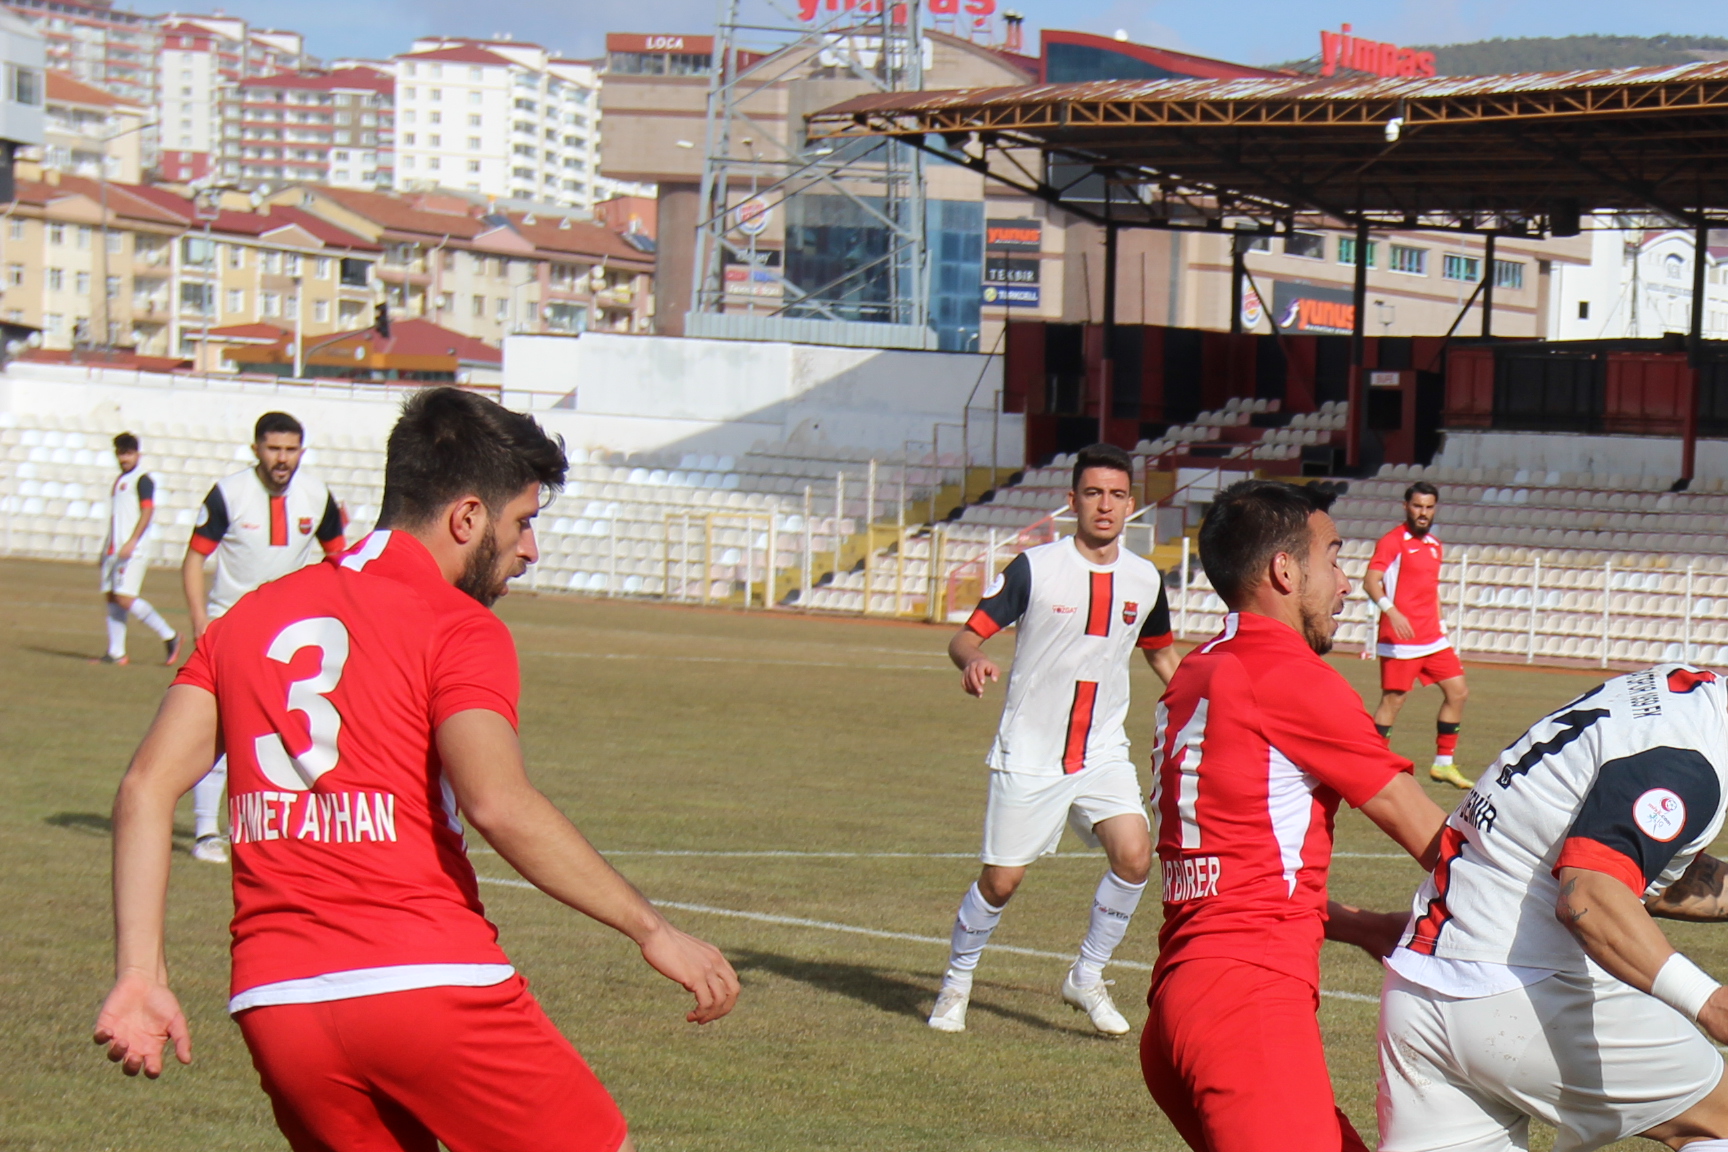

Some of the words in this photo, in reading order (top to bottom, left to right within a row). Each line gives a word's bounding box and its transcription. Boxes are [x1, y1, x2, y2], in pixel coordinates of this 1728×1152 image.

[645, 36, 684, 50] LOCA
[254, 616, 350, 791] 3
[297, 791, 397, 843] AYHAN
